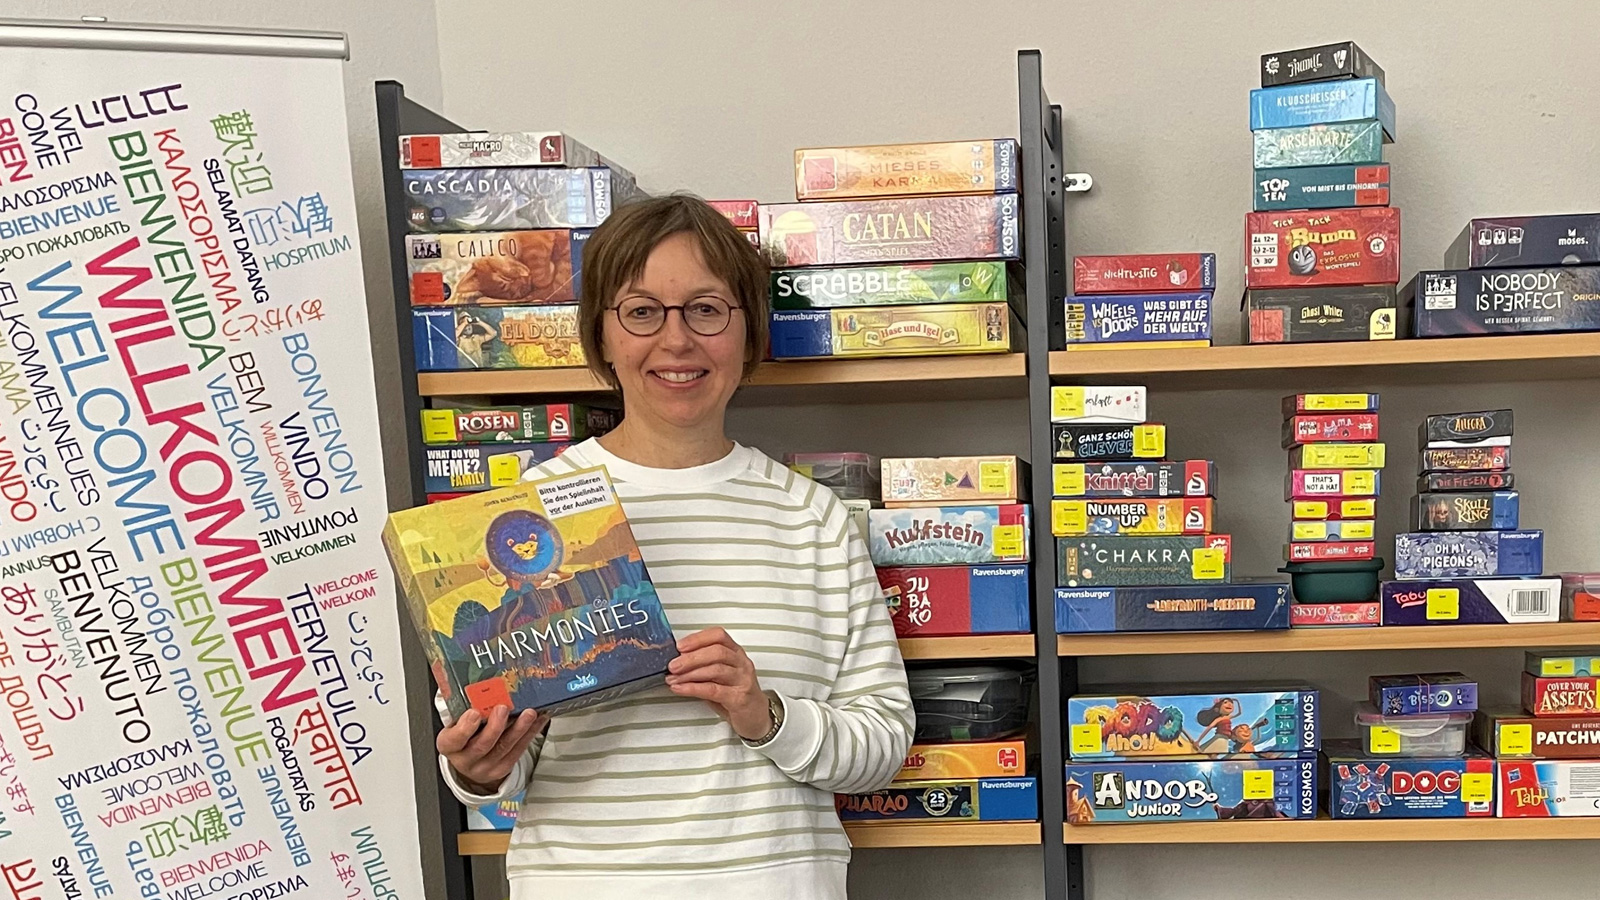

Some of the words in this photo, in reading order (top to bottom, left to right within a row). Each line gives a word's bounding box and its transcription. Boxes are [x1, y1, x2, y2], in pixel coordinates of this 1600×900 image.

[15, 94, 60, 169] COME
[50, 107, 83, 163] WEL
[1280, 131, 1353, 151] ARSCHKARTE
[0, 118, 33, 182] BIEN
[473, 141, 502, 151] MACRO
[870, 160, 941, 173] MIESES
[1000, 143, 1009, 187] KOSMOS
[0, 171, 117, 213] ΑΛΩΣΟΡΙΣΜΑ
[409, 178, 513, 195] CASCADIA
[1260, 178, 1290, 192] TOP
[1318, 184, 1333, 192] MIST
[1262, 192, 1286, 201] TEN
[0, 195, 120, 239] BIENVENUE
[843, 211, 932, 242] CATAN
[1001, 196, 1013, 256] KOSMOS
[1273, 217, 1294, 228] TICK
[1308, 215, 1331, 226] TACK
[27, 221, 130, 255] ПОЖАЛОВАТЬ
[204, 158, 245, 234] SELAMAT
[233, 238, 269, 304] DATANG
[1289, 228, 1356, 247] Bumm
[108, 130, 226, 371] BIENVENIDA
[457, 238, 517, 258] CALICO
[1558, 237, 1589, 246] moses.
[263, 235, 352, 272] HOSPITIUM
[1320, 252, 1361, 265] EXPLOSIVE
[1325, 262, 1361, 271] WORTSPIEL!
[777, 269, 911, 298] SCRABBLE
[1482, 272, 1561, 292] NOBODY
[1092, 302, 1136, 320] WHEELS
[1144, 301, 1166, 311] WAS
[1169, 300, 1192, 309] GIBT
[1195, 300, 1208, 309] ES
[1302, 306, 1320, 319] Ghost
[1323, 305, 1343, 318] Writer
[1476, 295, 1490, 311] IS
[773, 313, 826, 322] Ravensburger
[1092, 320, 1102, 329] VS
[1144, 311, 1180, 322] MEHR
[1182, 310, 1208, 321] AUF
[501, 324, 524, 340] EL
[881, 326, 902, 338] Hase
[904, 324, 921, 333] und
[923, 324, 939, 337] Igel
[1102, 316, 1139, 338] DOORS
[1144, 323, 1166, 334] DER
[1169, 322, 1207, 334] WELT?
[229, 352, 272, 414] BEM
[26, 260, 186, 562] WELCOME
[282, 332, 362, 494] BONVENON
[458, 415, 515, 433] ROSEN
[1078, 433, 1104, 444] GANZ
[1105, 429, 1133, 441] SCHÖN
[206, 373, 281, 523] VELKOMNIR
[279, 411, 329, 500] VINDO
[427, 450, 449, 460] WHAT
[451, 449, 462, 459] DO
[464, 449, 480, 459] YOU
[1078, 440, 1133, 457] CLEVER
[85, 236, 319, 713] WILLKOMMEN
[260, 420, 305, 515] WILLKOMMEN
[428, 459, 480, 477] MEME?
[451, 472, 485, 487] FAMILY
[539, 487, 556, 495] Bitte
[557, 476, 601, 494] kontrollieren
[1085, 472, 1153, 490] Kniffel
[1454, 476, 1488, 487] FIESEN
[555, 493, 568, 502] den
[569, 485, 605, 499] Spielinhalt
[549, 507, 561, 516] vor
[562, 503, 574, 511] der
[575, 495, 606, 508] Ausleihe!
[1087, 503, 1147, 516] NUMBER
[1454, 497, 1491, 511] SKULL
[1119, 514, 1141, 528] UP
[1458, 509, 1489, 523] KING
[11, 519, 85, 552] НОВЫМ
[258, 507, 359, 548] POWITANIE
[271, 533, 356, 565] VELKOMMEN
[1095, 548, 1190, 564] CHAKRA
[1435, 544, 1448, 554] OH
[1451, 543, 1465, 554] MY
[2, 555, 52, 579] ANNUS
[1423, 555, 1480, 568] PIGEONS!
[313, 569, 378, 596] WELCOME
[973, 568, 1025, 577] Ravensburger
[906, 577, 929, 593] JU
[1058, 590, 1110, 599] Ravensburger
[319, 586, 376, 611] WELKOM
[906, 592, 931, 608] BA
[1392, 590, 1426, 606] Tabu
[86, 537, 168, 696] VELKOMMEN
[908, 608, 932, 626] KO
[1293, 606, 1327, 618] SKYJO
[44, 588, 88, 669] SAMBUTAN
[470, 599, 649, 668] HARMONIES
[1, 582, 84, 721] ありがとう
[50, 549, 151, 744] BENVENUTO
[160, 557, 272, 768] BIENVENUE
[287, 583, 373, 767] TERVETULOA
[1547, 682, 1569, 691] COVER
[1571, 681, 1589, 690] YOUR
[126, 576, 181, 661] добро
[169, 667, 246, 827] пожаловать
[1304, 695, 1315, 748] KOSMOS
[1106, 732, 1156, 752] Ahoi!
[1281, 736, 1289, 744] 25
[266, 716, 315, 813] FOGADTATÁS
[101, 762, 205, 806] WELCOME
[982, 781, 1033, 789] Ravensburger
[1095, 773, 1218, 808] ANDOR
[1302, 762, 1312, 815] KOSMOS
[1392, 770, 1460, 795] DOG
[97, 780, 212, 828] BIENVENIDA
[834, 795, 909, 815] PHARAO
[930, 793, 945, 803] 25
[1510, 786, 1549, 808] Tabu
[257, 764, 312, 867] BIENVENUE
[1127, 803, 1182, 818] JUNIOR
[54, 793, 114, 900] BIENVENUE
[160, 839, 272, 888] BIENVENIDA
[167, 861, 268, 900] WELCOME
